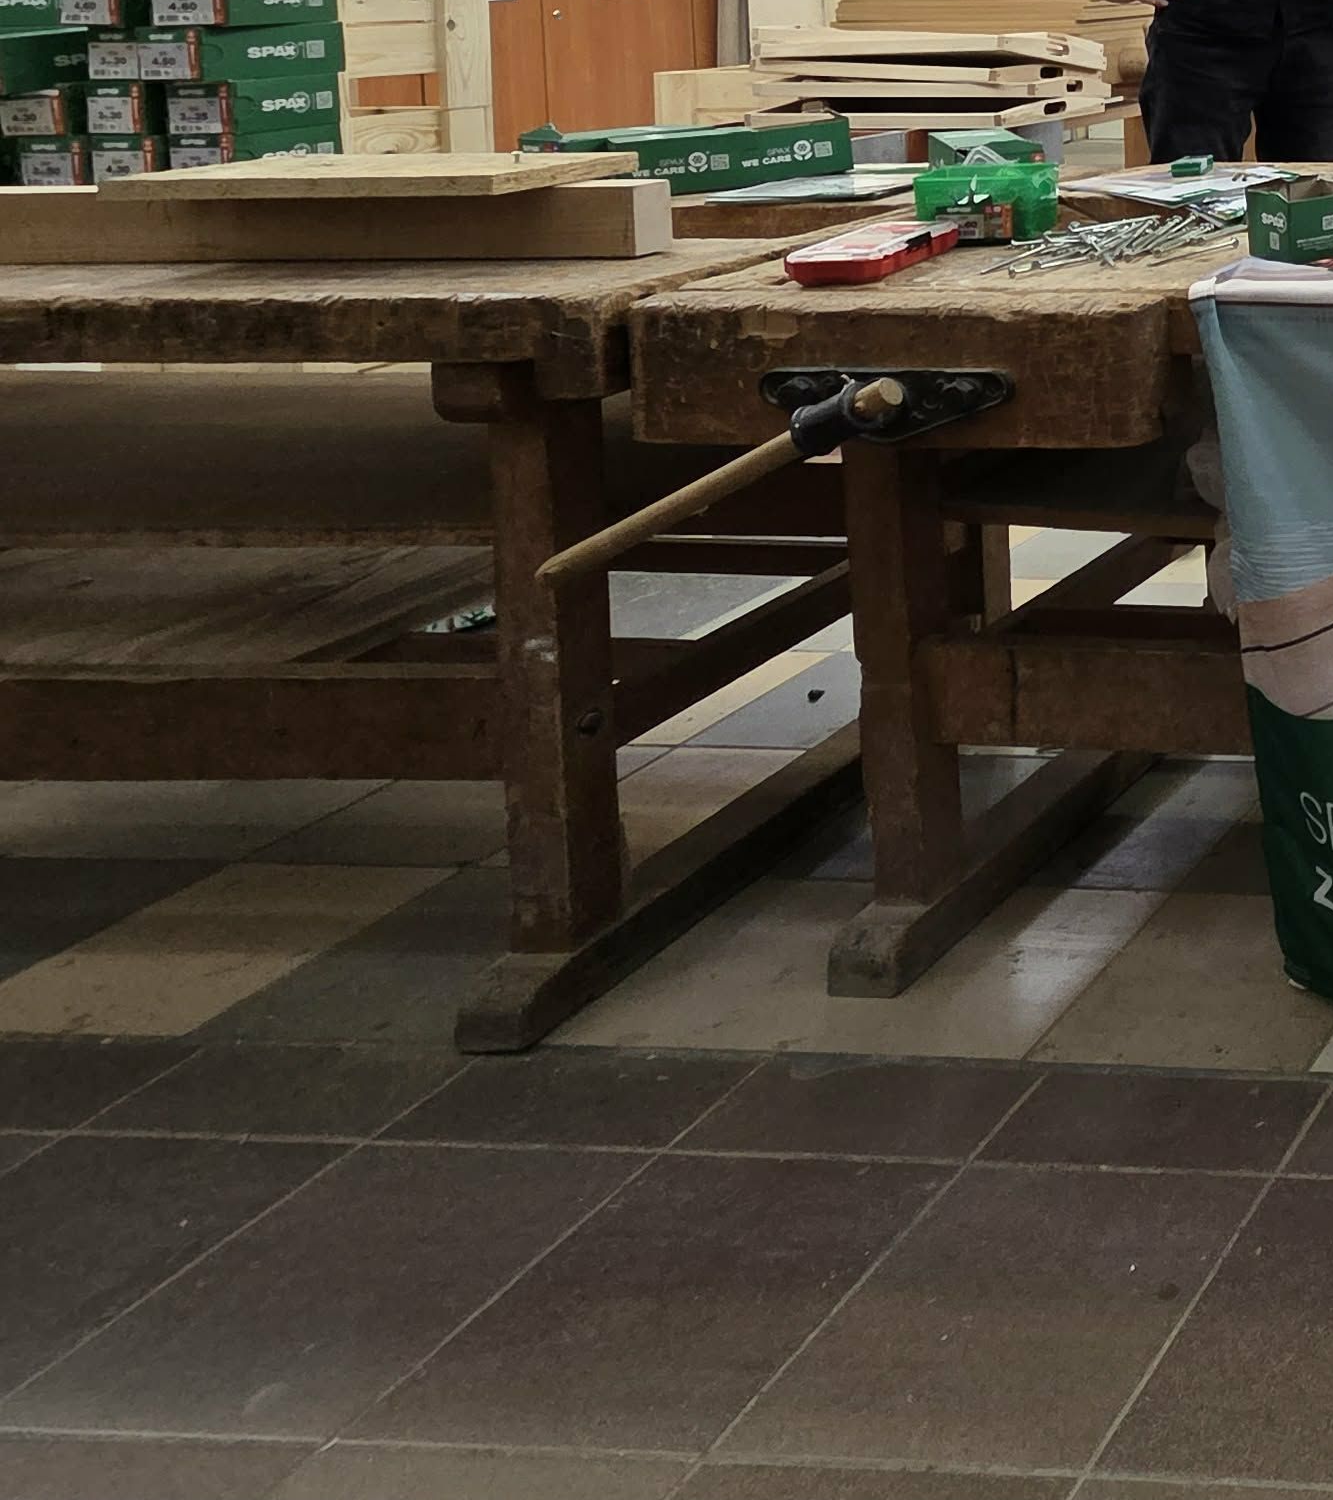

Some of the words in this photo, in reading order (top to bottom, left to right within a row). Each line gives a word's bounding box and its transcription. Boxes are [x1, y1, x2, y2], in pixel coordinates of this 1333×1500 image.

[247, 45, 297, 60] SPAX
[53, 53, 89, 68] SP
[261, 97, 307, 113] SPAX
[741, 158, 760, 168] WE
[762, 154, 793, 166] CARE
[654, 165, 686, 177] CARE
